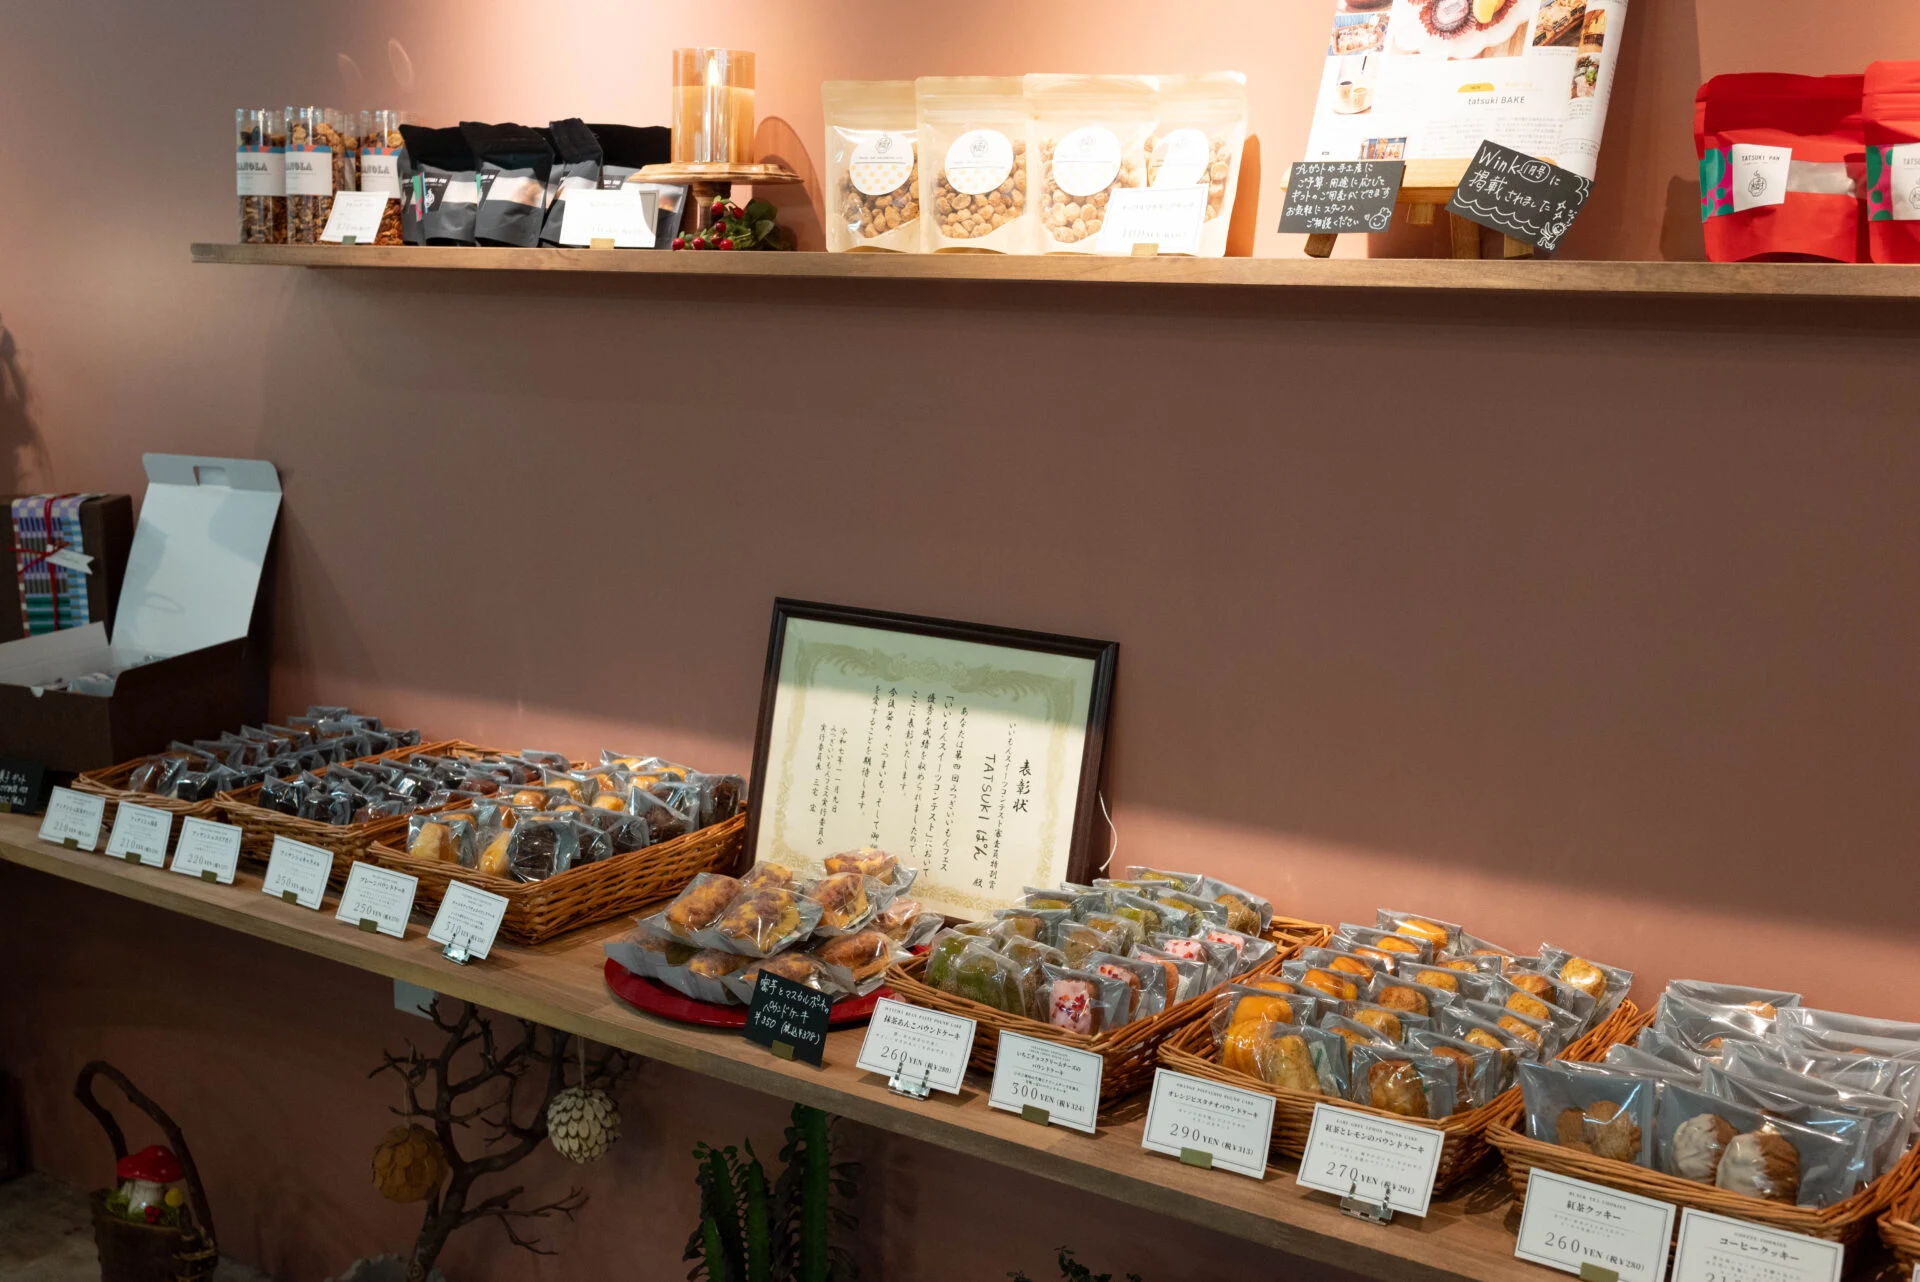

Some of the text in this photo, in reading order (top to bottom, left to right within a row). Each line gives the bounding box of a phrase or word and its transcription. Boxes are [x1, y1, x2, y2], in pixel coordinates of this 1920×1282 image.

[1467, 94, 1526, 106] tatsuki BAKE
[1478, 145, 1561, 187] Wink 1月号 に
[1741, 153, 1781, 163] TATSUKI PAN
[1468, 169, 1552, 213] 掲載されました
[1306, 215, 1360, 230] ご相談ください
[899, 689, 918, 797] ここに表彰いたします。
[977, 753, 996, 821] TATSUKI
[1012, 758, 1032, 813] 表彰状
[973, 829, 988, 861] ぱん
[353, 902, 372, 916] 250
[762, 1000, 810, 1024] パウンドケーキ
[883, 1014, 961, 1041] 抹茶あんこパウンドケーキ
[880, 1045, 908, 1063] 260
[908, 1057, 923, 1067] YEN
[1011, 1082, 1038, 1100] 300
[1040, 1093, 1055, 1104] YEN
[1168, 1090, 1259, 1120] オレンジピスタチオパウンドケーキ
[1169, 1122, 1200, 1143] 290
[1203, 1135, 1220, 1146] YEN
[1325, 1123, 1425, 1154] 紅茶とレモンのパウンドケーキ
[1325, 1161, 1359, 1182] 270
[1361, 1174, 1379, 1186] YEN
[1566, 1199, 1622, 1221] 紅茶クッキー
[1544, 1231, 1580, 1254] 260
[1582, 1246, 1604, 1259] YEN
[1719, 1236, 1801, 1262] コーヒークッキー
